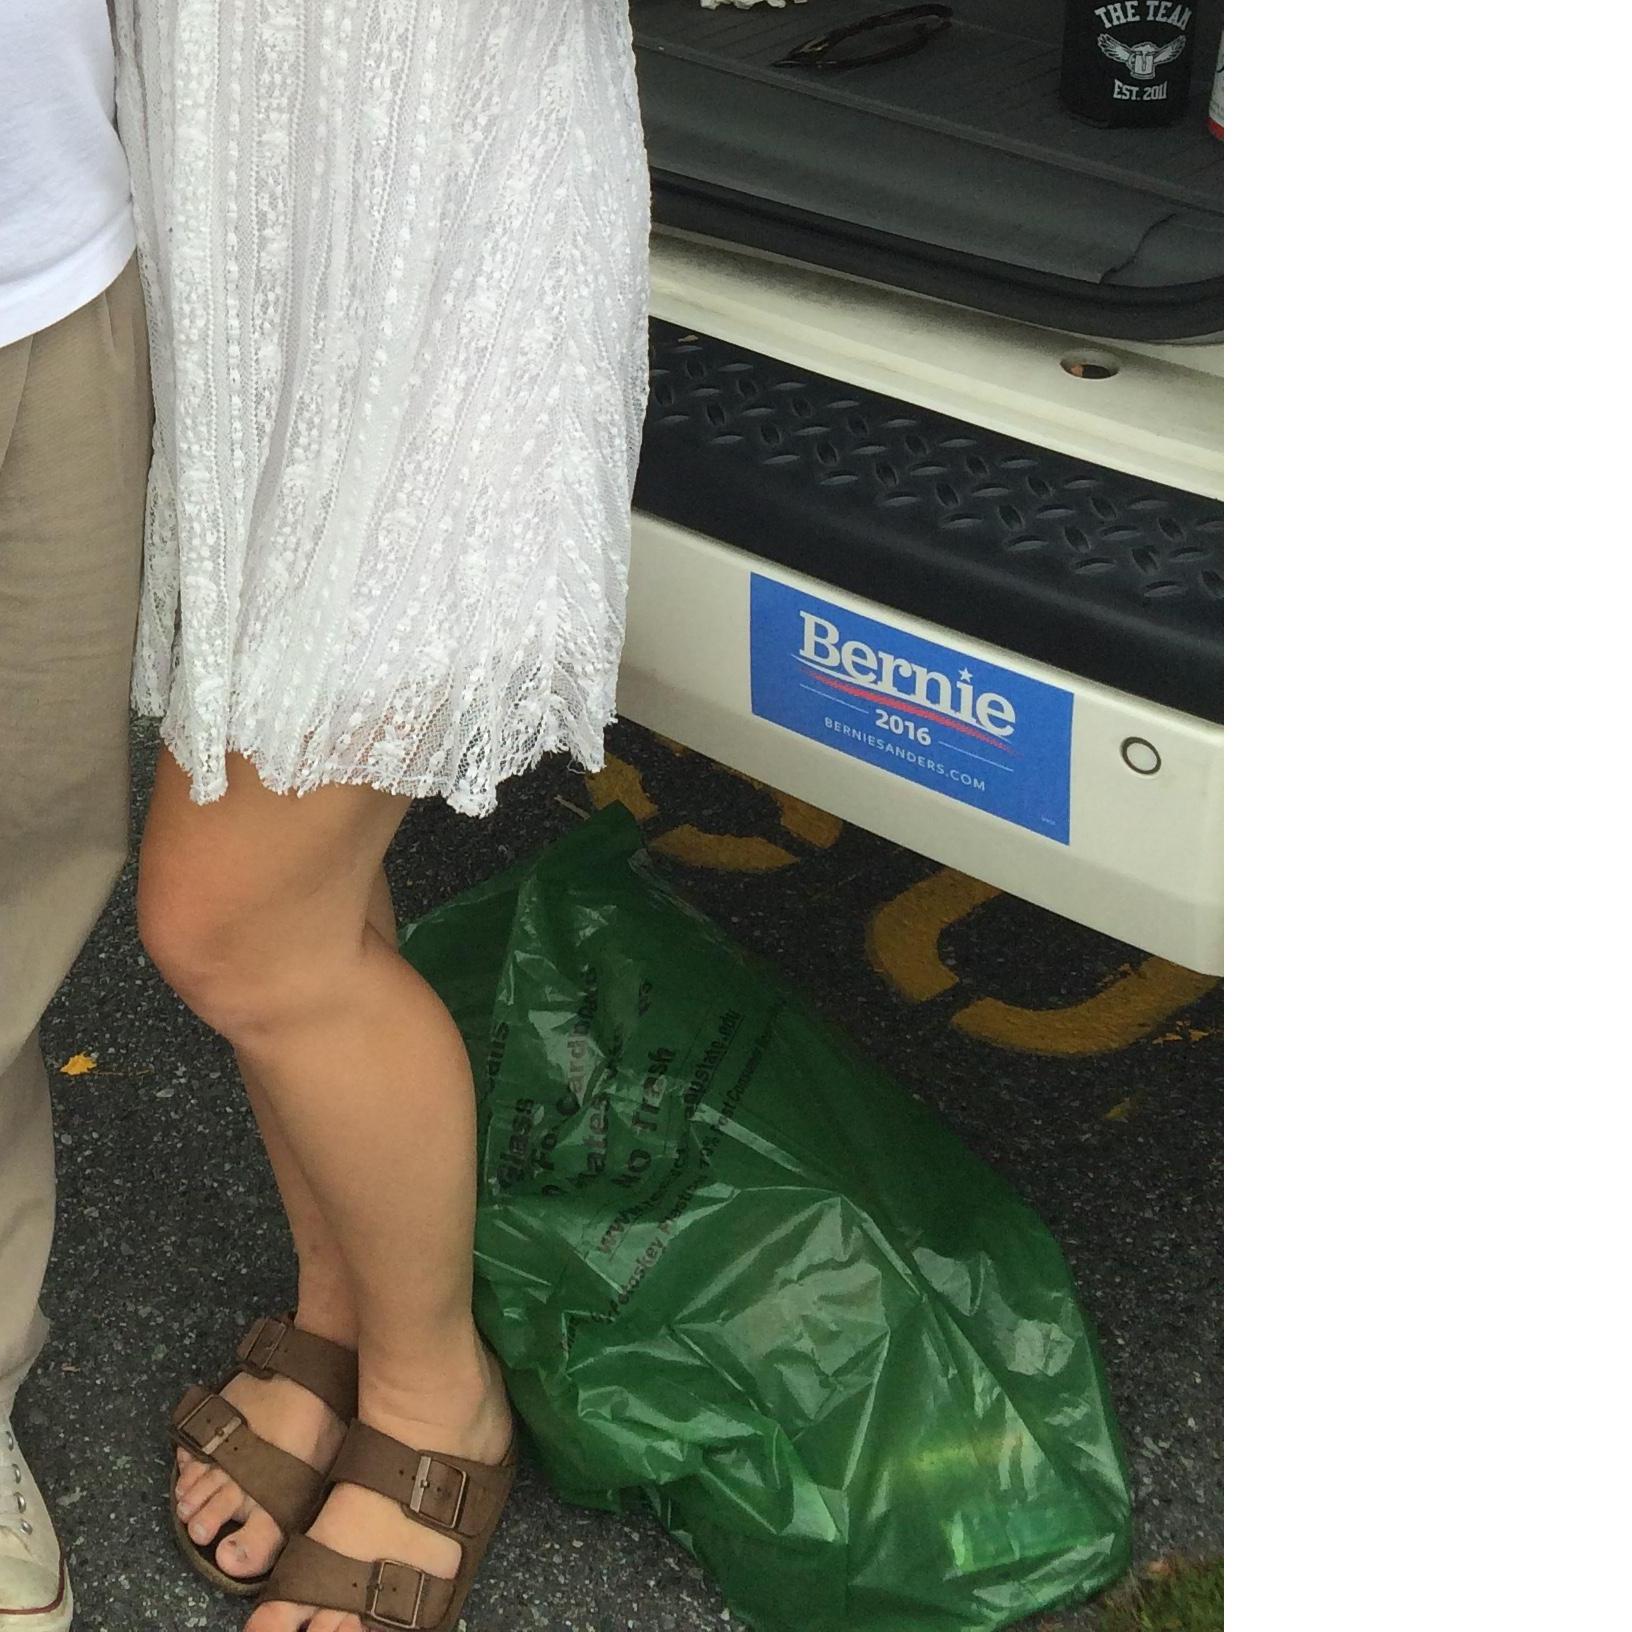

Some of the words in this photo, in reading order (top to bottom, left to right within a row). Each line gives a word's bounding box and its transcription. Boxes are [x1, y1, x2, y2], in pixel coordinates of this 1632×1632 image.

[1094, 0, 1140, 28] THE
[1113, 79, 1141, 100] EST.
[1143, 80, 1168, 100] 2011
[799, 610, 1016, 737] Bernie
[875, 709, 932, 745] 2016
[824, 717, 986, 792] BERNIESANDERS.COM
